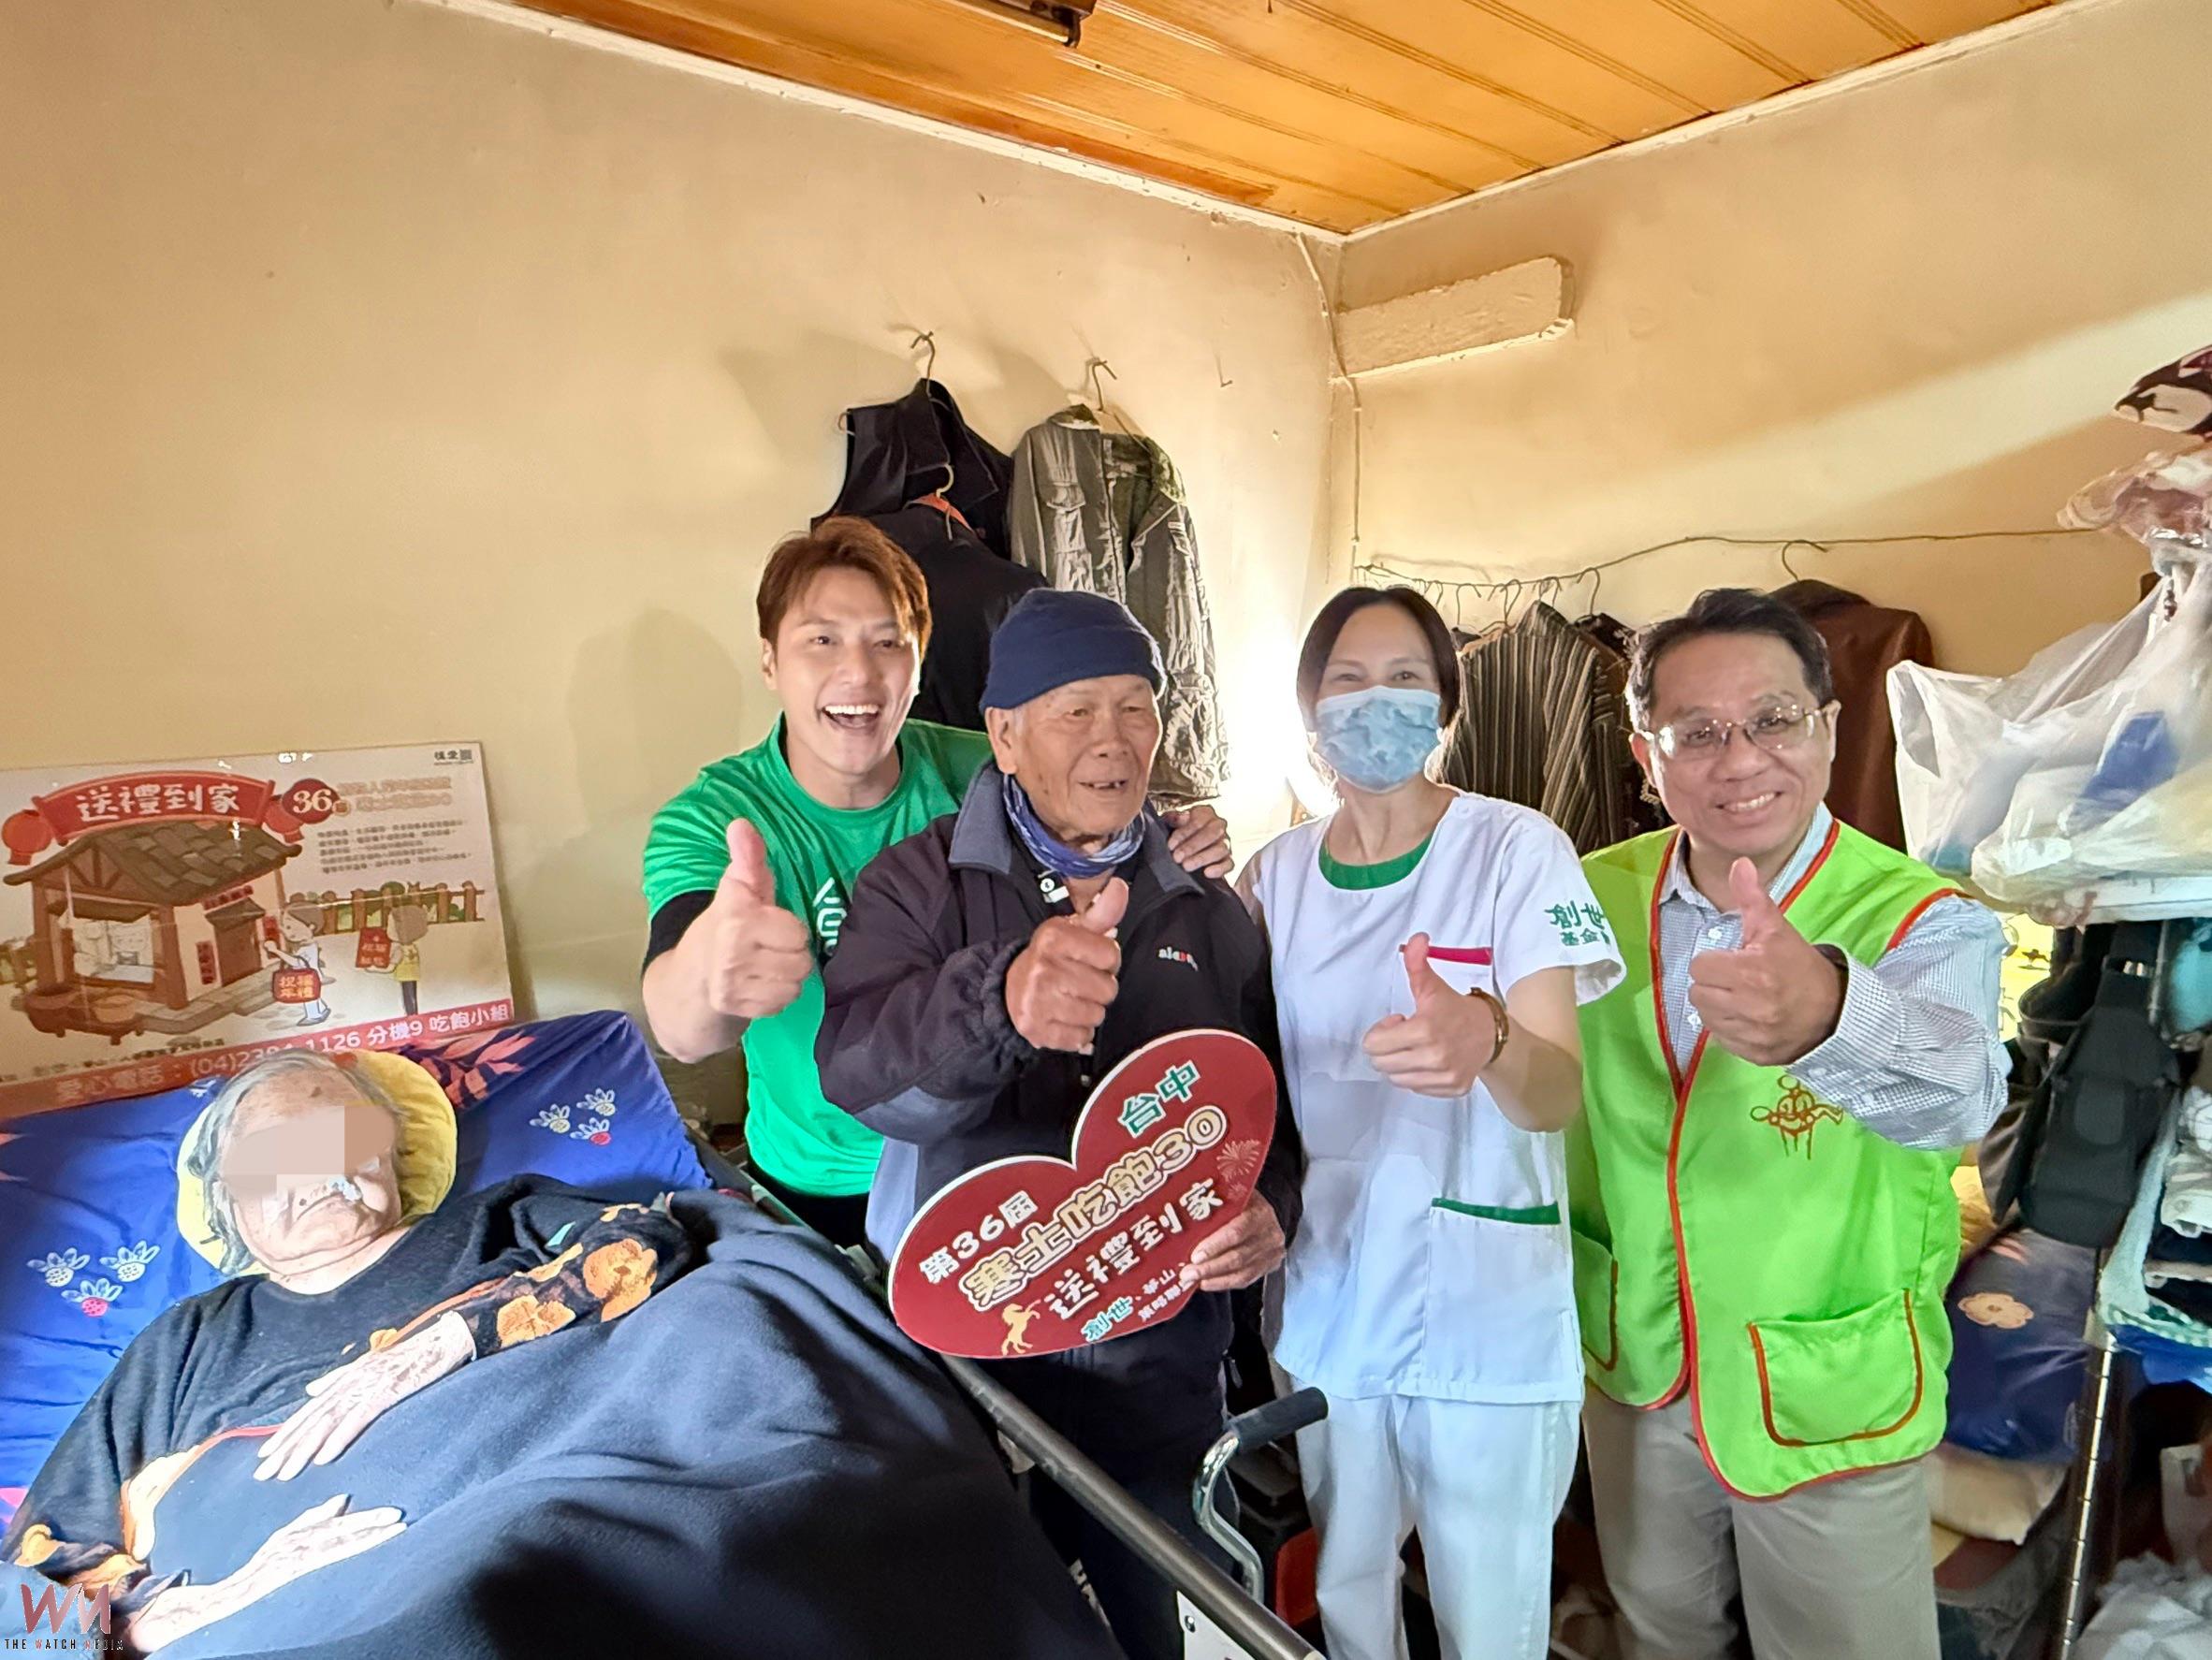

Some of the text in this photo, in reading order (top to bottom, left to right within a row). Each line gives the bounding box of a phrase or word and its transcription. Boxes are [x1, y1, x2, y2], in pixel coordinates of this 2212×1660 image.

[76, 783, 240, 822] 送禮到家
[292, 789, 332, 813] 36
[367, 1020, 423, 1045] 分機9
[429, 1004, 509, 1032] 吃飽小組
[1117, 1059, 1201, 1139] 台中
[918, 1189, 1039, 1285] 第36屆
[958, 1105, 1228, 1312] 寒士吃飽30
[1043, 1177, 1225, 1320] 送禮到家
